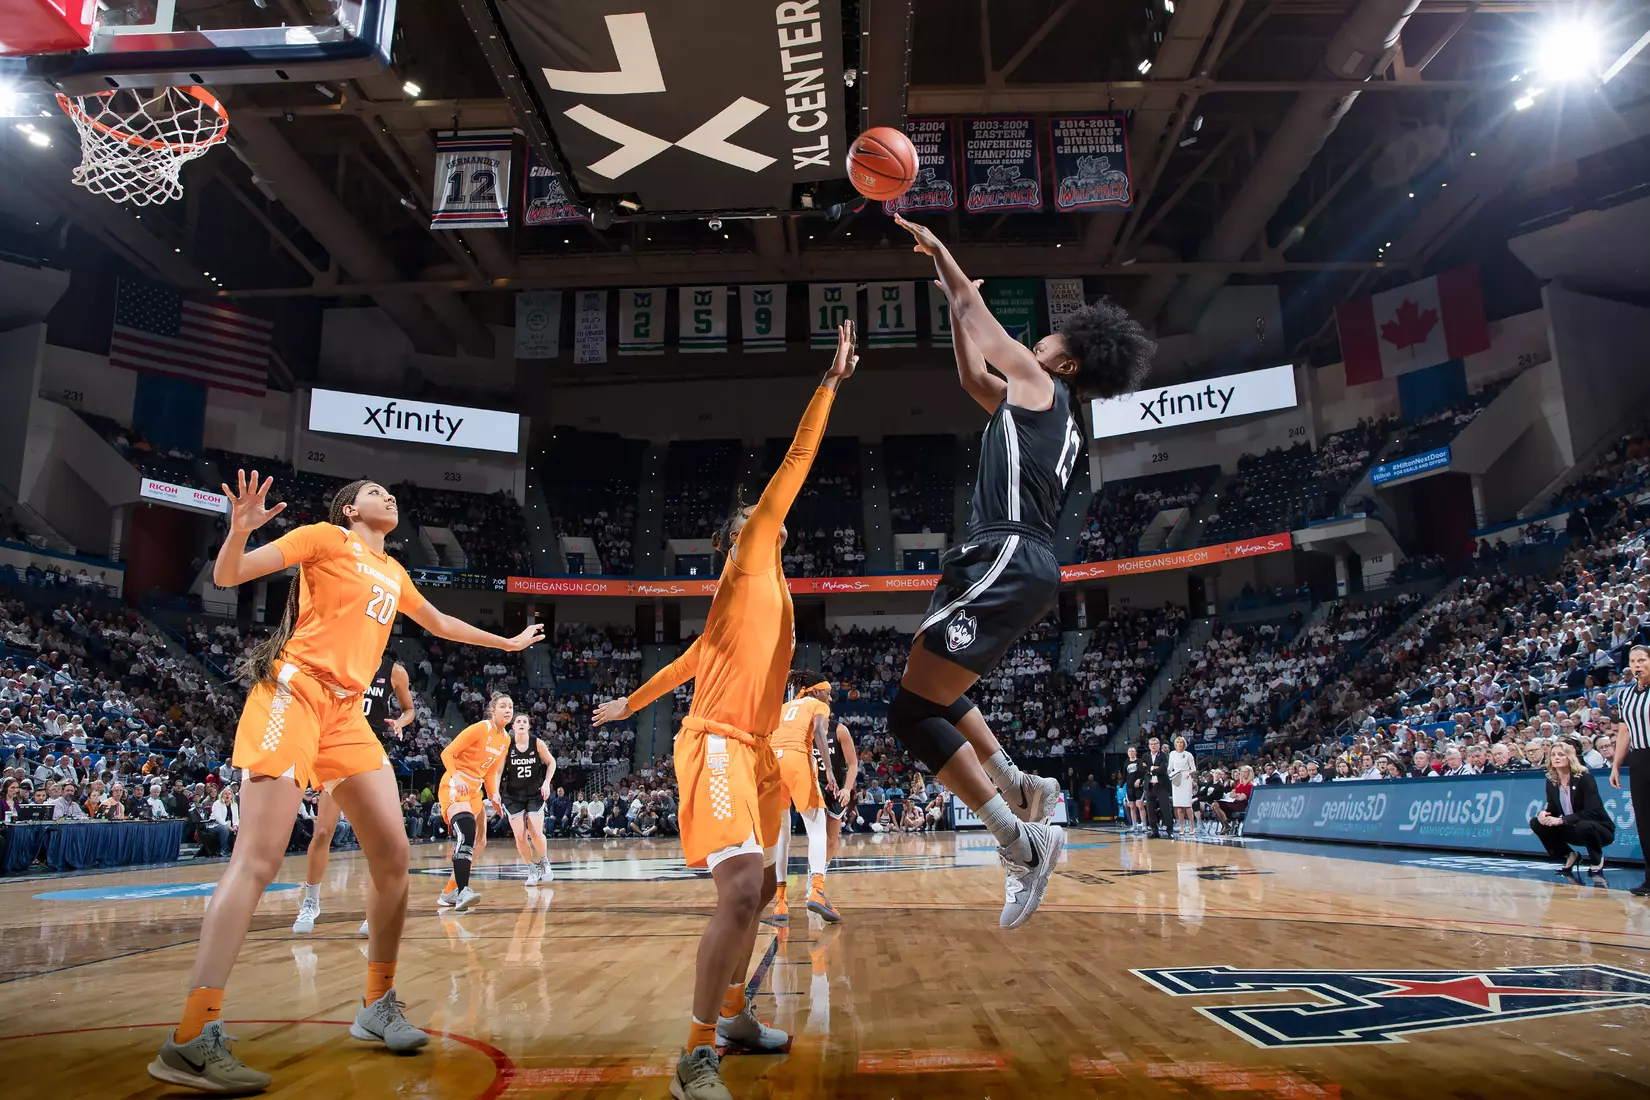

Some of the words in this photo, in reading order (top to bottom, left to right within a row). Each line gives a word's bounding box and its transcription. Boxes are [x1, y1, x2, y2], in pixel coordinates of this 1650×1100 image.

[972, 121, 1029, 130] 2003-2004
[1059, 119, 1115, 129] 2014-2015
[975, 129, 1026, 139] EASTERN
[1054, 128, 1122, 137] NORTHEAST
[967, 139, 1032, 149] CONFERENCE
[1063, 136, 1114, 145] DIVISION
[967, 149, 1031, 159] CHAMPIONS
[1056, 144, 1123, 154] CHAMPIONS
[446, 156, 500, 169] GERNANDER
[447, 170, 496, 204] 12
[694, 309, 712, 333] 5
[755, 308, 772, 334] 9
[819, 305, 848, 330] 10
[878, 304, 905, 329] 11
[634, 312, 650, 338] 2
[63, 389, 84, 402] 231
[1140, 384, 1235, 424] xfinity
[363, 402, 464, 441] xfinity
[1288, 426, 1306, 438] 240
[307, 451, 325, 463] 232
[1152, 452, 1169, 463] 239
[1392, 451, 1447, 470] #HiltonNextDoor
[1404, 465, 1418, 473] DEALS
[1419, 461, 1428, 469] AND
[444, 472, 461, 482] 233
[1373, 472, 1391, 480] Hilton
[149, 482, 178, 494] RICOH
[193, 492, 221, 503] RICOH
[1267, 540, 1283, 550] Sun
[1117, 551, 1209, 572] MOHEGANSUN.COM
[420, 571, 426, 580] 2
[514, 580, 607, 592] MOHEGANSUN.COM
[671, 585, 685, 593] Sun
[365, 584, 396, 625] 20
[511, 757, 536, 765] UCONN
[517, 766, 532, 778] 25
[1252, 794, 1305, 824] genius3D
[1313, 793, 1387, 827] genius3D
[1398, 791, 1504, 830] genius3D
